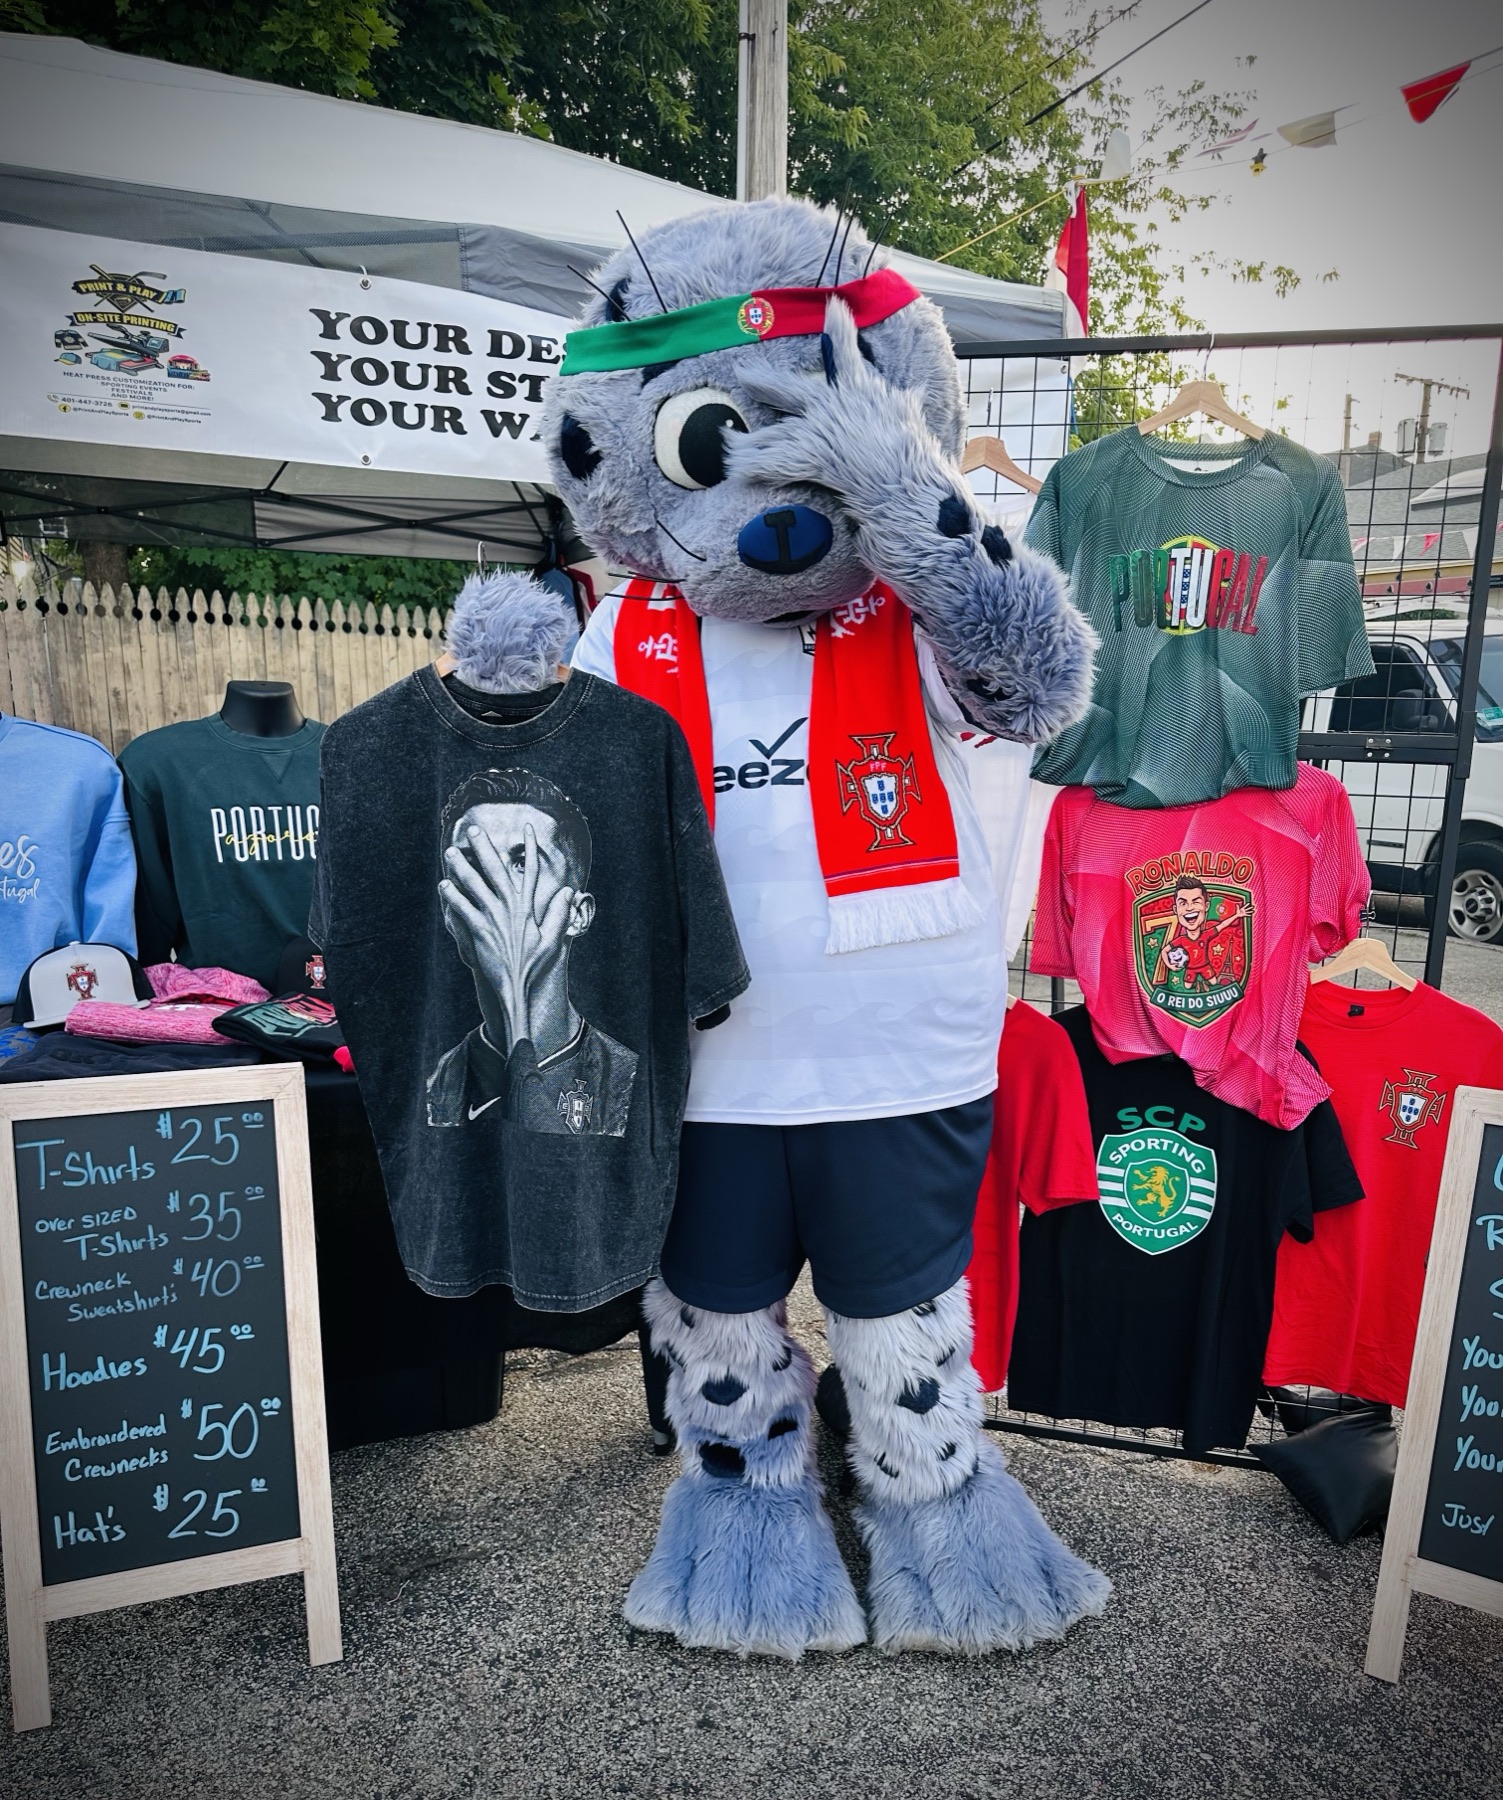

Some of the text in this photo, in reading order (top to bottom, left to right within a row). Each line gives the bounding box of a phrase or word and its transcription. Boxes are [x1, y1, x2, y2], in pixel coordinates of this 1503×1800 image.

[79, 282, 157, 299] PRINT & PLAY
[76, 313, 176, 332] ON-SITE PRINTING
[309, 308, 568, 365] YOUR DE
[63, 371, 84, 379] HEAT
[113, 377, 176, 388] CUSTOMIZATION
[101, 381, 138, 389] SPORTING
[310, 350, 473, 396] YOUR
[111, 388, 153, 396] FESTIVALS
[311, 392, 542, 442] YOUR W
[1109, 548, 1270, 636] PORTUGAL
[713, 759, 810, 794] eez
[869, 761, 888, 772] FPF
[0, 875, 40, 904] tugal
[1125, 852, 1254, 897] RONALDO
[1141, 912, 1180, 985] 7
[1157, 987, 1239, 1009] O REI DO SIUUU
[1117, 1105, 1206, 1134] SCP
[15, 1138, 156, 1190] T-Shirts
[1109, 1138, 1206, 1174] SPORTING
[63, 1224, 169, 1261] T-Shirts
[1112, 1213, 1198, 1239] PORTUGAL
[35, 1271, 132, 1301] Crewneck
[42, 1352, 148, 1391] Hoodies
[1459, 1384, 1503, 1423] You
[64, 1447, 169, 1482] Crewnecks
[54, 1506, 126, 1549] Hat's
